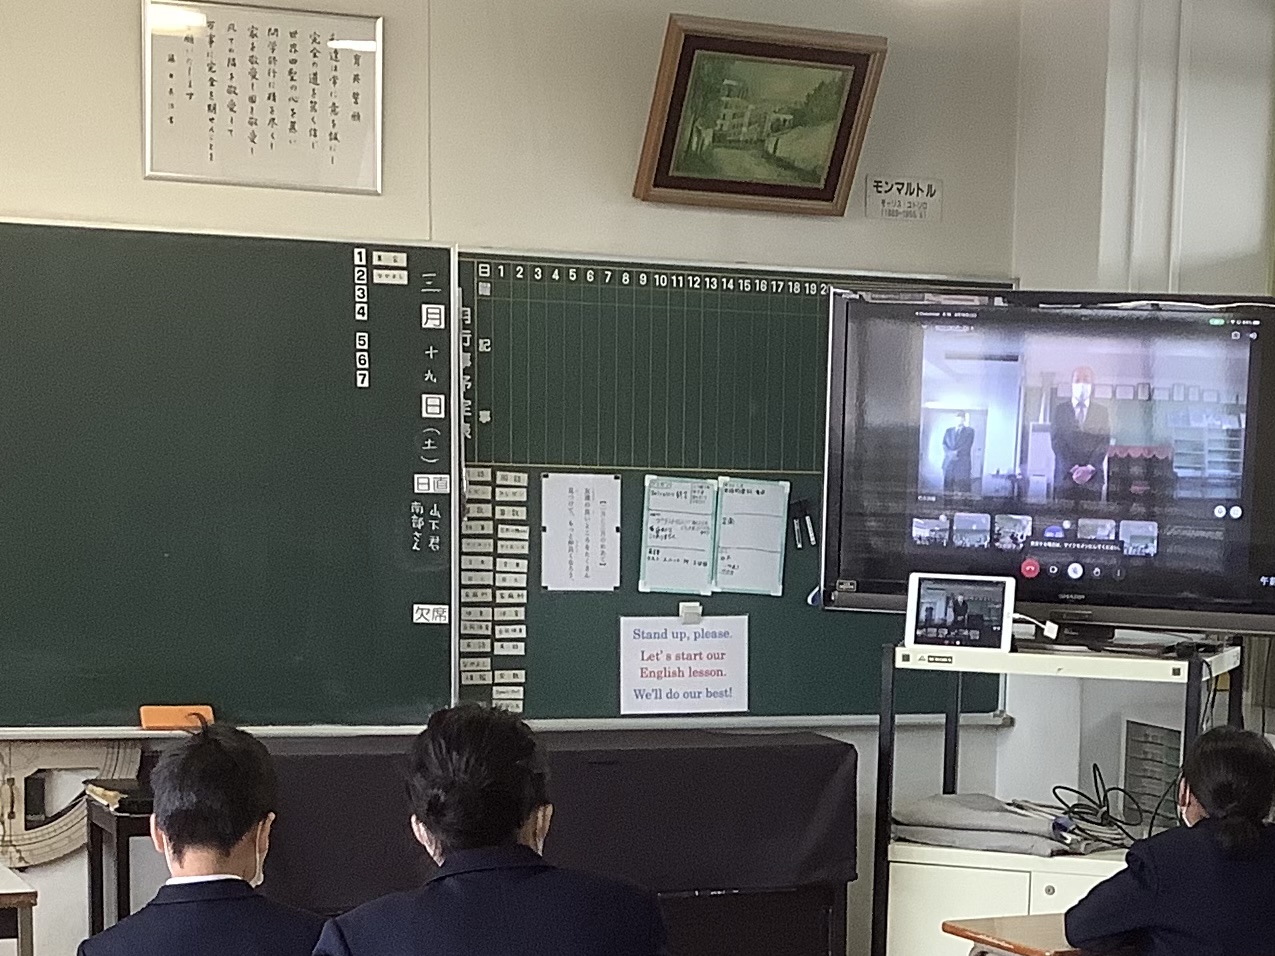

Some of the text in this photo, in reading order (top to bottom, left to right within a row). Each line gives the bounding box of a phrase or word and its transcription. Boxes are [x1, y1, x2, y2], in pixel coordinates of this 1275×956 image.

[873, 180, 936, 198] モンマルトル
[479, 264, 490, 277] 日
[498, 265, 504, 277] 1
[516, 266, 523, 278] 2
[534, 267, 542, 279] 3
[552, 269, 560, 280] 4
[569, 269, 577, 281] 5
[586, 270, 594, 282] 6
[604, 271, 612, 283] 7
[622, 272, 630, 284] 8
[639, 273, 647, 285] 9
[654, 274, 667, 287] 10
[671, 275, 683, 288] 11
[687, 276, 700, 288] 12
[704, 277, 718, 289] 13
[721, 278, 734, 290] 14
[738, 279, 751, 291] 15
[754, 280, 767, 292] 16
[771, 281, 784, 293] 17
[788, 282, 801, 294] 18
[804, 282, 817, 295] 19
[416, 477, 449, 491] 日直
[415, 606, 447, 622] 欠席
[632, 628, 733, 641] Stand up, please.
[640, 650, 726, 661] Let's start our
[639, 666, 727, 680] English lesson.
[633, 687, 733, 700] We'll do our best!
